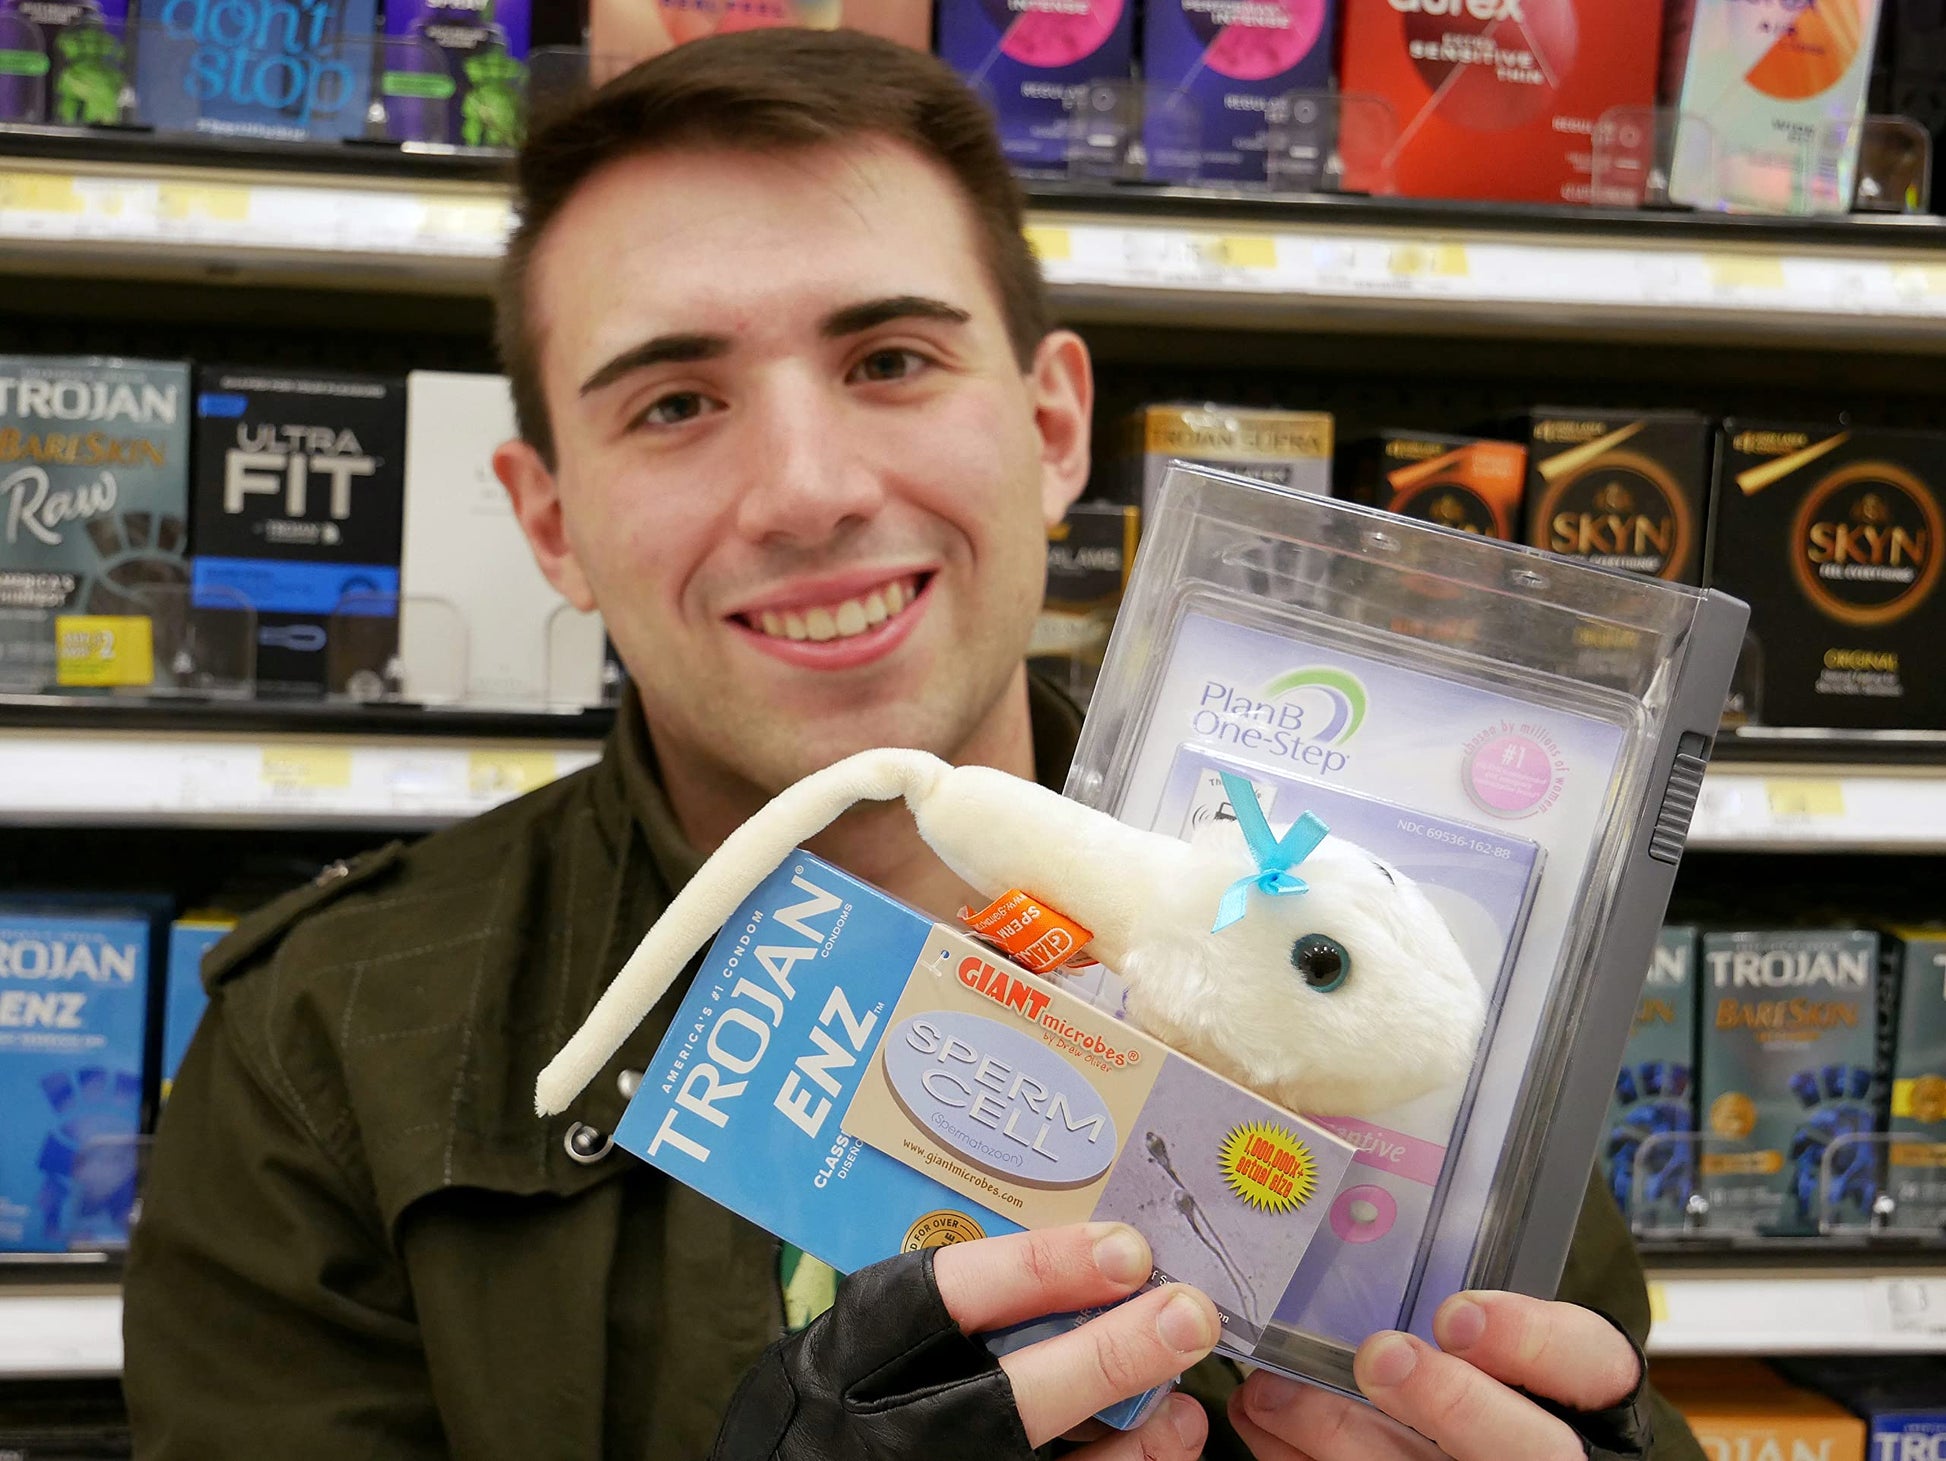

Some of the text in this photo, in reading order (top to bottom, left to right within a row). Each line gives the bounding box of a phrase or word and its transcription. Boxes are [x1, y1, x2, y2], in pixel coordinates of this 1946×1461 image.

[1409, 40, 1535, 69] SENSITIVE
[183, 46, 355, 127] stop
[0, 376, 178, 424] TROJAN
[236, 421, 364, 456] ULTRA
[223, 449, 377, 520] FIT
[0, 466, 118, 546] Raw
[1551, 512, 1673, 556] SKYN
[1807, 521, 1927, 566] SKYN
[1462, 725, 1498, 757] chosen
[1500, 719, 1516, 734] by
[1519, 723, 1561, 758] millions
[1501, 743, 1527, 770] #1
[1554, 760, 1570, 773] of
[1538, 777, 1566, 815] women
[1396, 819, 1512, 860] NDC 69536-162-88
[820, 902, 853, 959] CONDOMS
[996, 904, 1041, 939] SPERM
[0, 940, 137, 983] OJAN
[1705, 950, 1870, 989] TROJAN
[0, 990, 88, 1029] ENZ
[661, 909, 764, 1095] AMERICA'S #1 CONDOM
[1043, 1031, 1114, 1073] by Drew Oliver
[905, 1019, 1107, 1144] SPERM
[920, 1067, 1059, 1163] CELL
[931, 1111, 1025, 1169] (Spermatozoon)
[902, 1136, 1025, 1210] www.giantmicrobes.com
[914, 1223, 931, 1242] FOR
[932, 1218, 960, 1229] OVER
